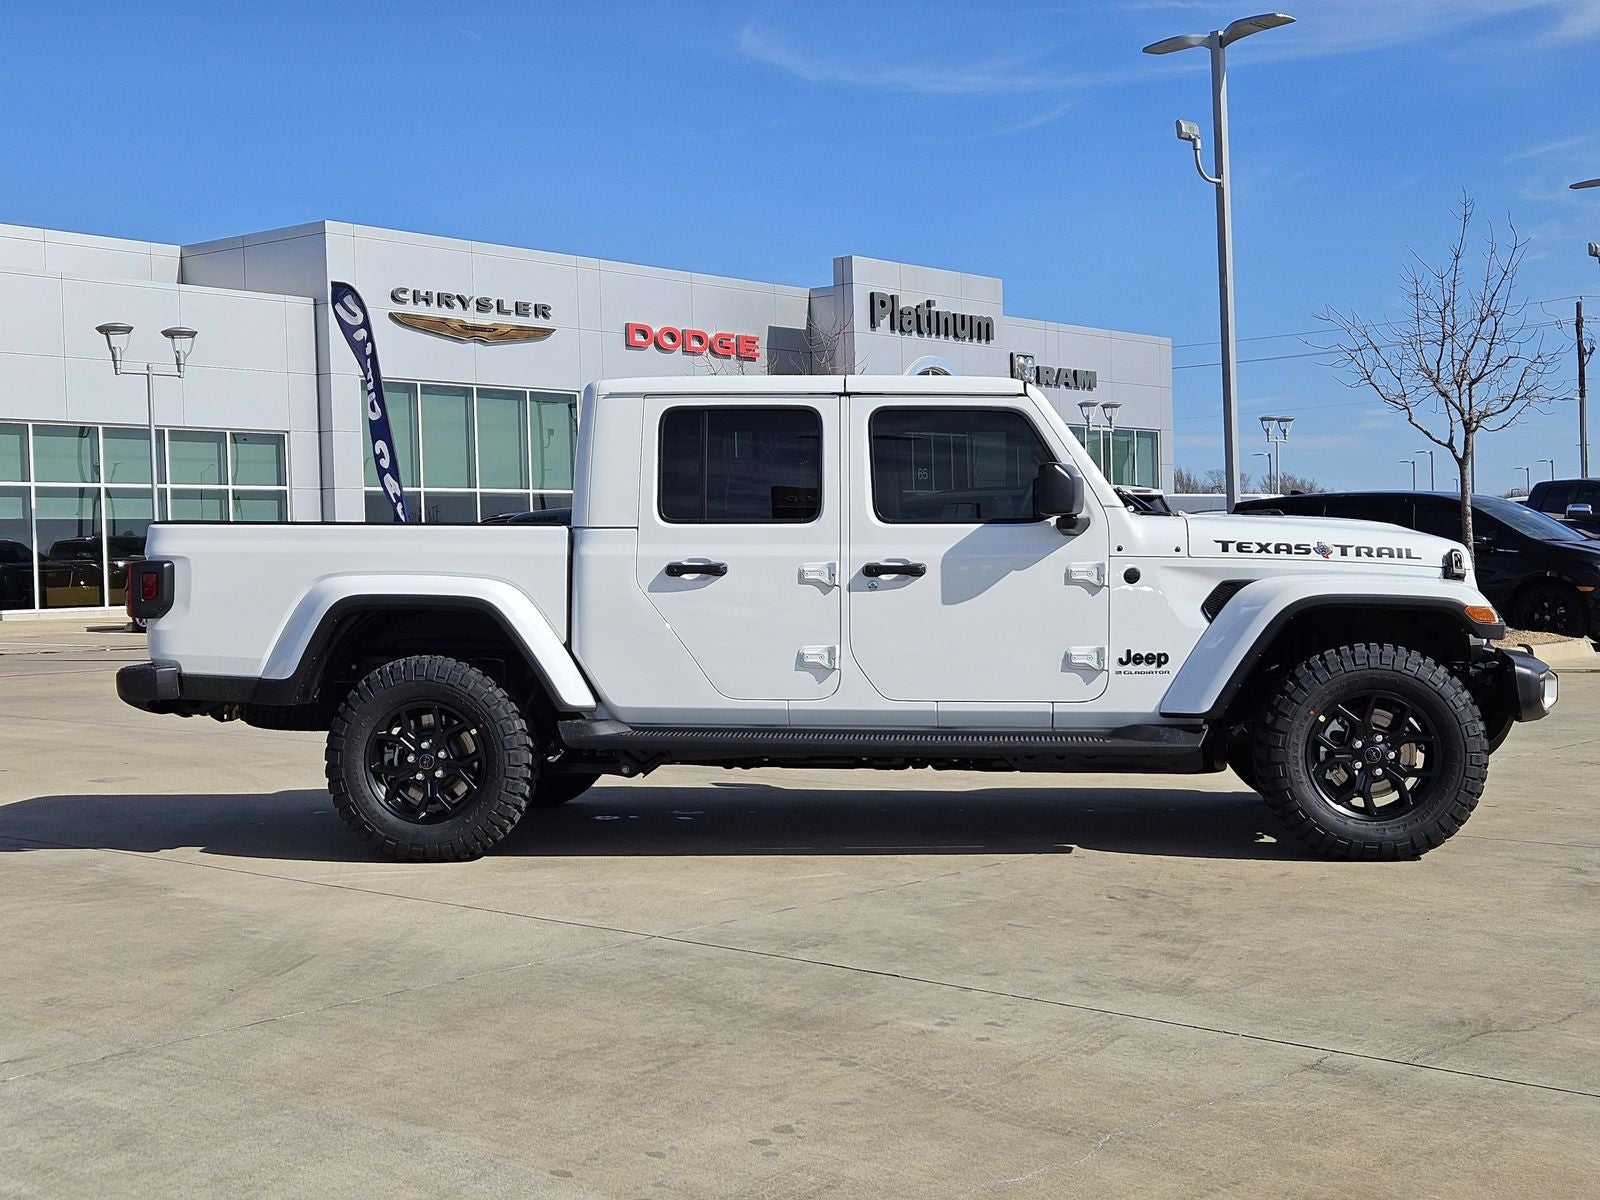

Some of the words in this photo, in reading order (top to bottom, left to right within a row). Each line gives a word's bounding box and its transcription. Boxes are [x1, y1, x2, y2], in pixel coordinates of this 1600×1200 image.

[390, 287, 553, 319] CHRYSLER
[870, 291, 995, 344] Platinum
[625, 322, 761, 361] DODGE
[1036, 365, 1097, 391] RAM
[1212, 539, 1312, 555] TEXAS
[1332, 544, 1422, 560] TRAIL
[1117, 648, 1169, 669] Jeep
